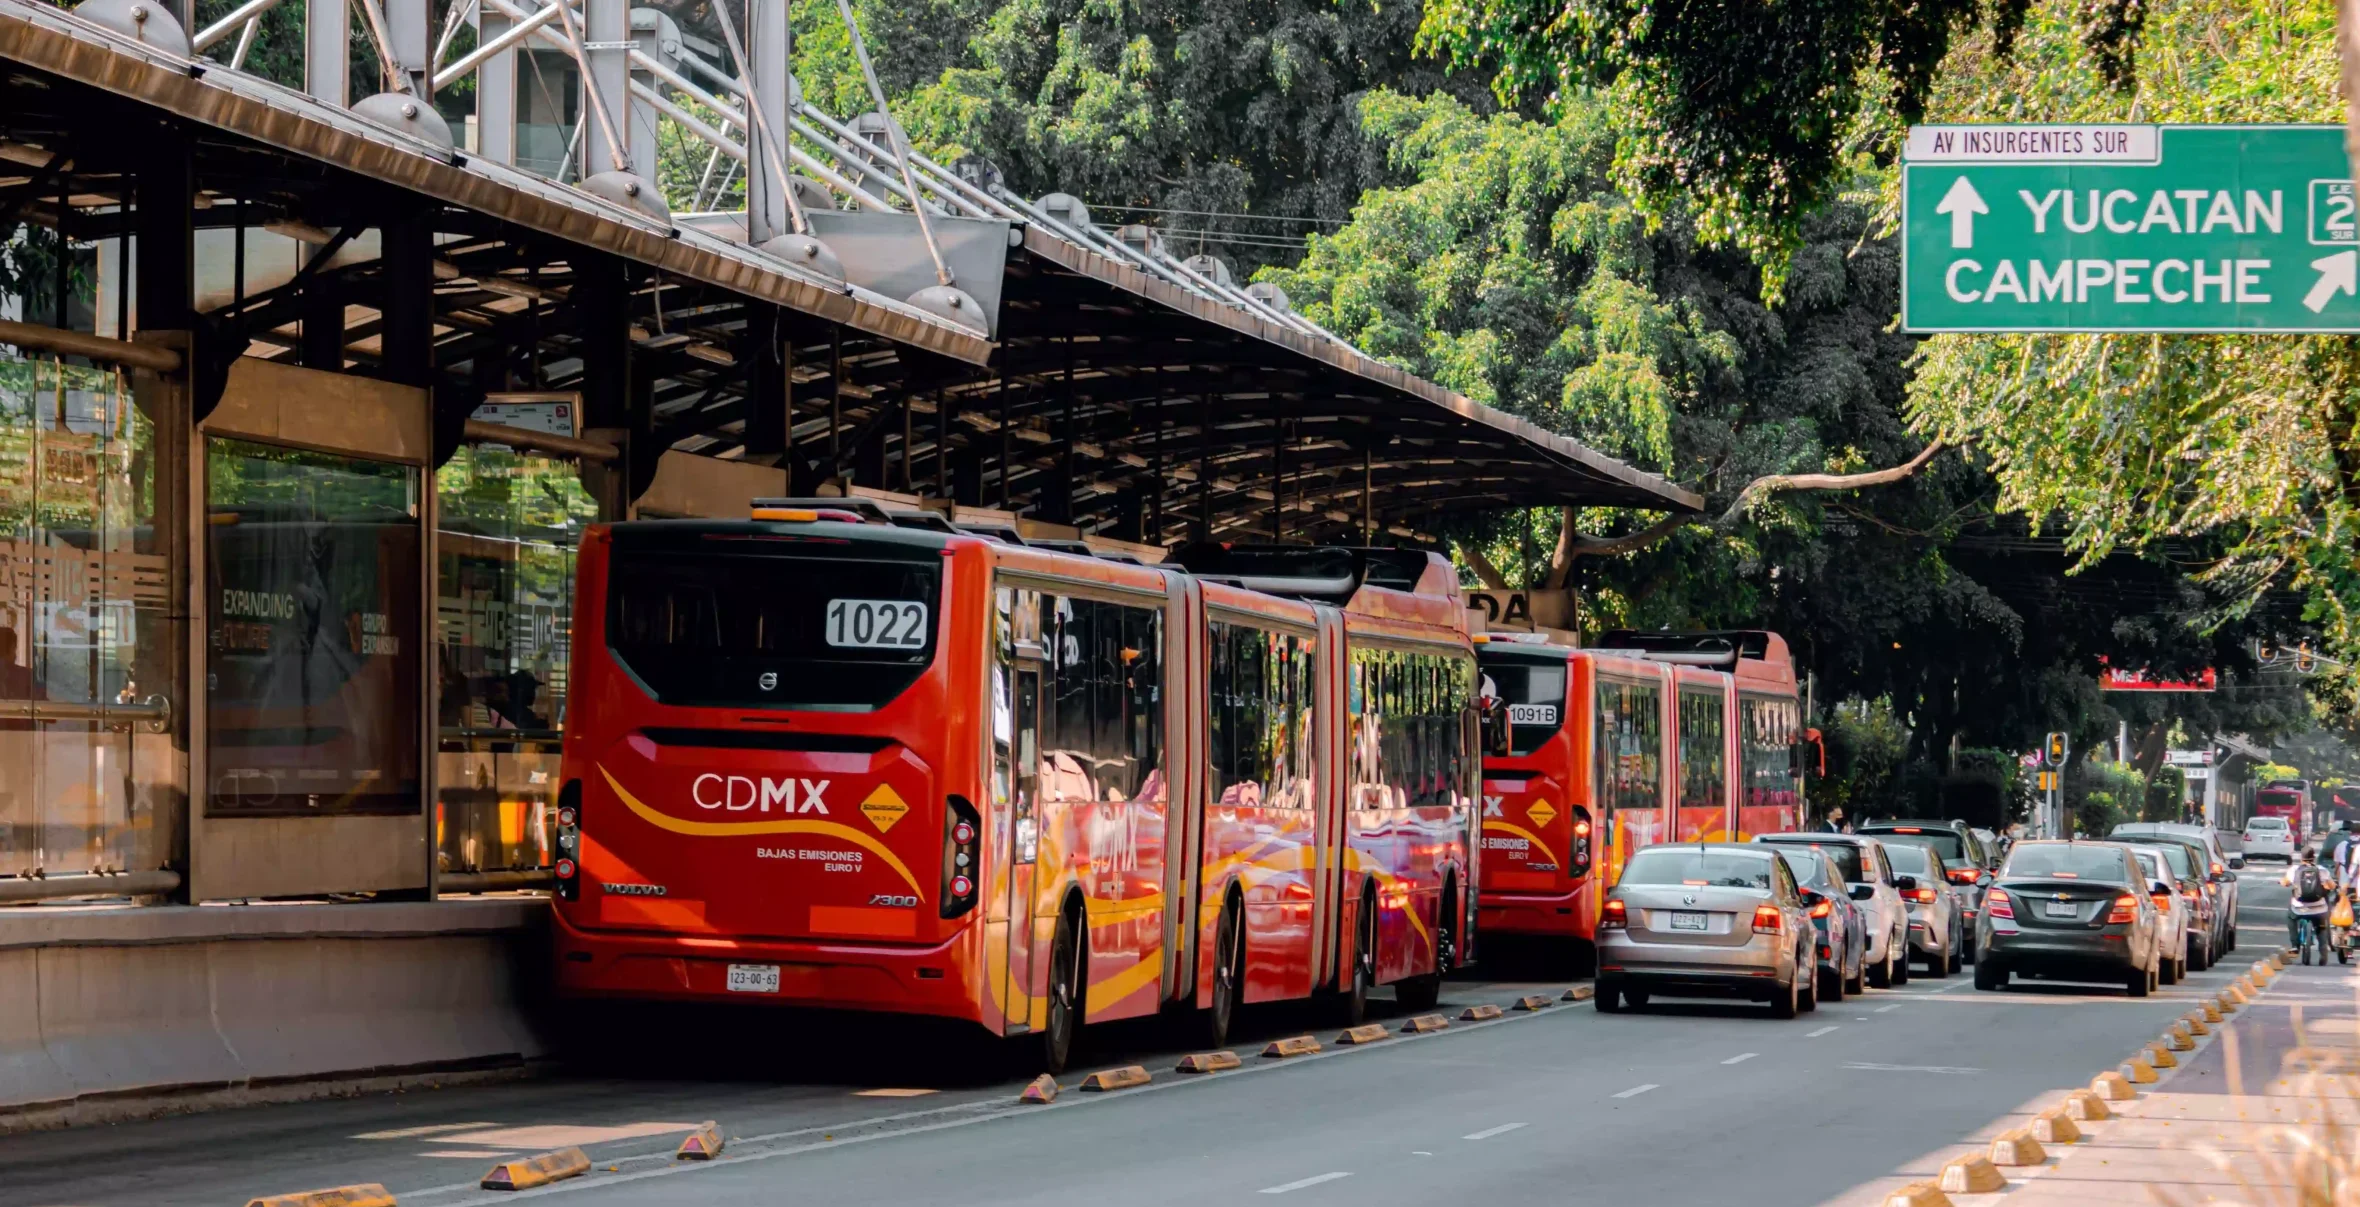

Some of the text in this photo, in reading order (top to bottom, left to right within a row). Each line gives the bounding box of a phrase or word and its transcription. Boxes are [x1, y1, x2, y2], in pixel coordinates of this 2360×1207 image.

[1933, 131, 2128, 154] AV INSURGENTES SUR
[2018, 189, 2283, 234] YUCATAN
[2326, 195, 2355, 231] 2
[2331, 230, 2354, 240] SUR
[1945, 259, 2271, 304] CAMPECHE
[223, 588, 295, 619] EXPANDING
[362, 613, 387, 632] GRUPO
[831, 602, 922, 645] 1022
[692, 773, 831, 815] CDMX
[1488, 838, 1530, 850] EMISIONES
[757, 848, 863, 862] BAJAS EMISIONES
[825, 863, 862, 873] EURO V
[601, 882, 667, 896] VOLVO
[868, 894, 918, 908] 7300
